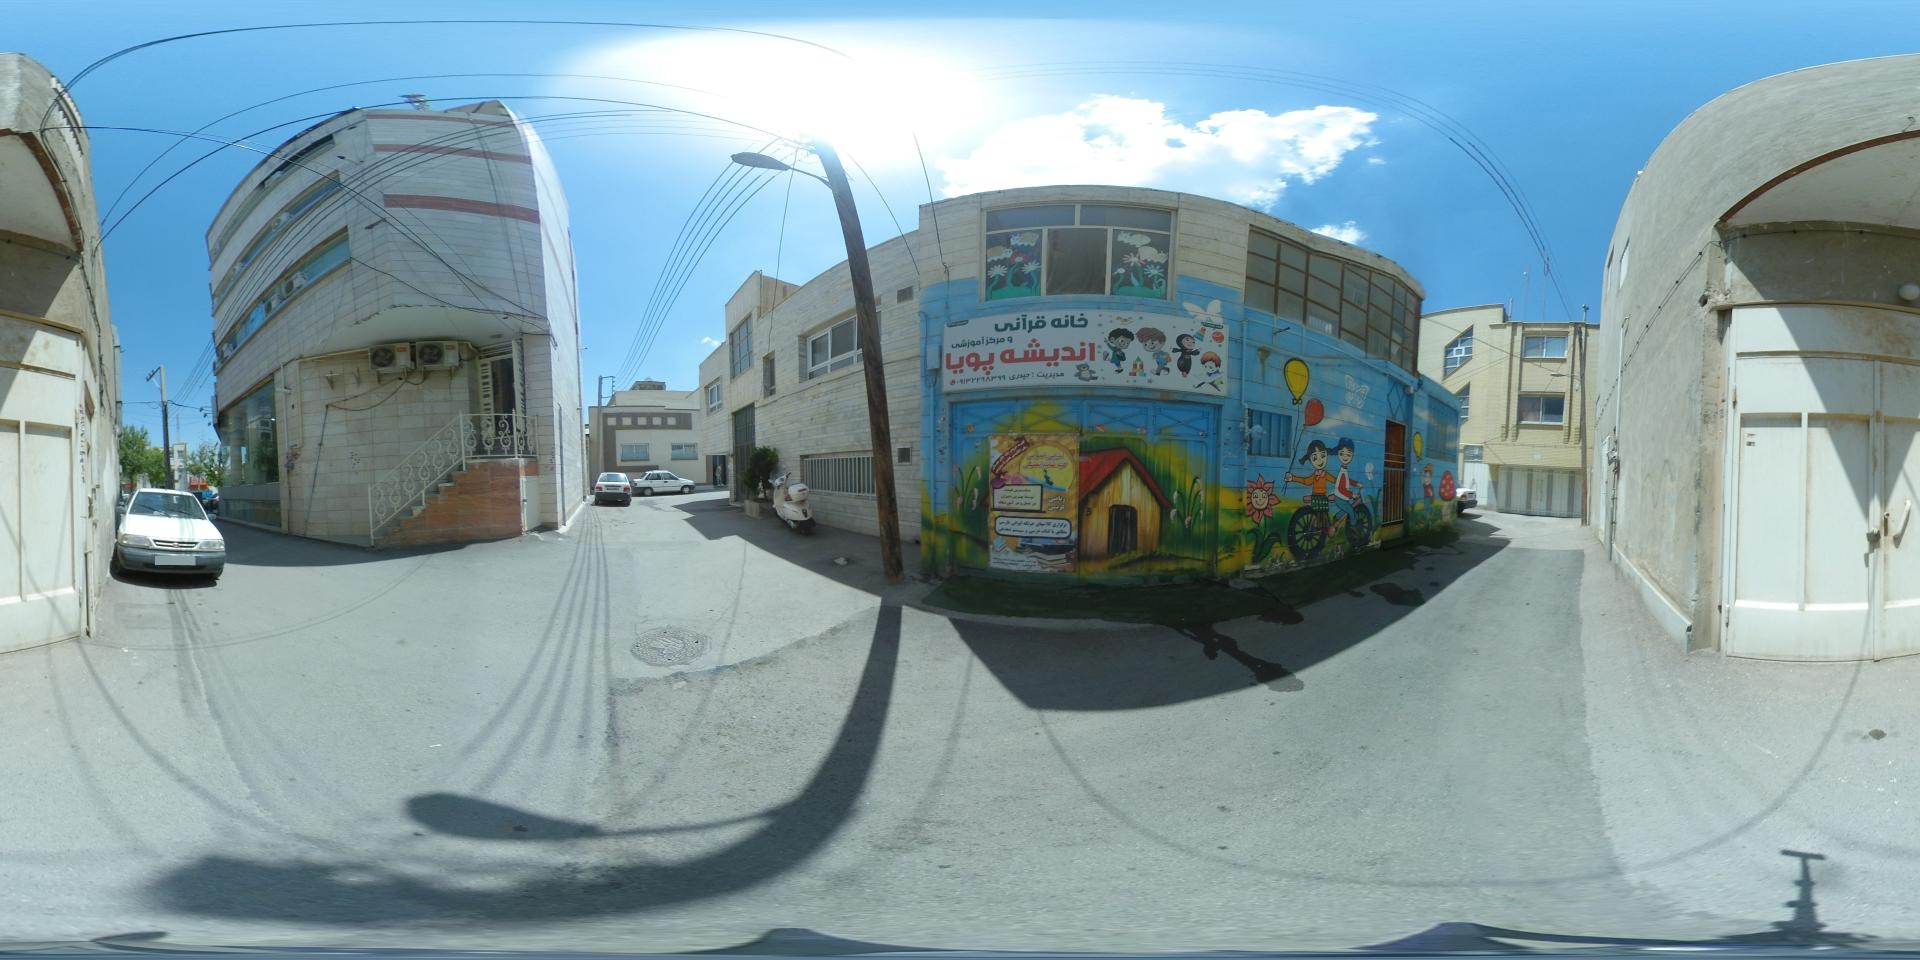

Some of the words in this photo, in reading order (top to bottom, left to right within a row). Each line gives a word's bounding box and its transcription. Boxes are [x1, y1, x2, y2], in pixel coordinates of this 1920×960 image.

[994, 314, 1047, 333] قرآنی
[1051, 313, 1089, 328] خانه
[951, 338, 985, 349] آموزشی
[985, 337, 1006, 346] مرکز
[999, 338, 1096, 367] اندیشه
[945, 351, 995, 375] پویا
[1036, 370, 1065, 379] مدیریت
